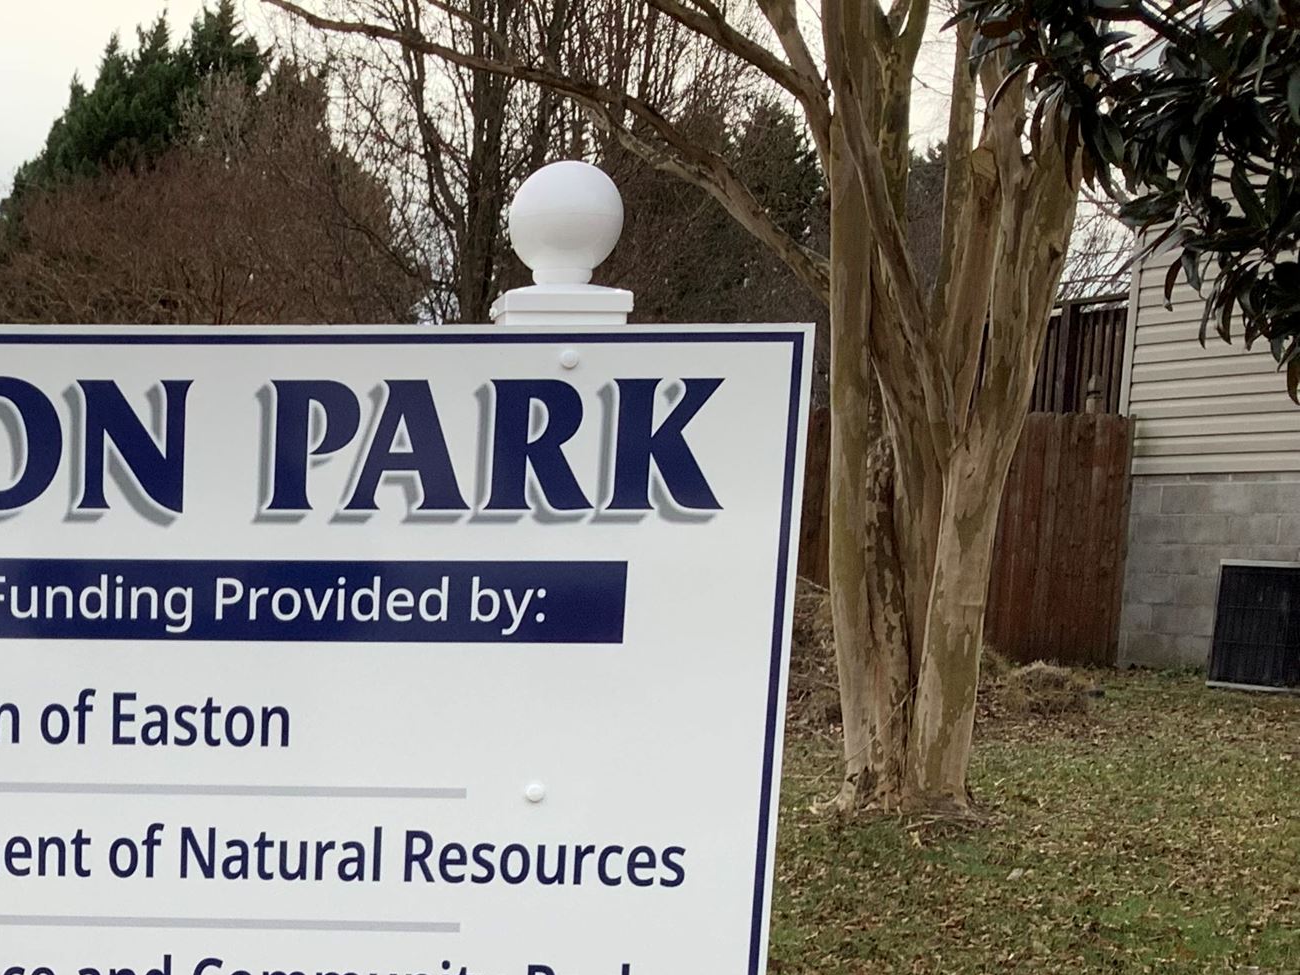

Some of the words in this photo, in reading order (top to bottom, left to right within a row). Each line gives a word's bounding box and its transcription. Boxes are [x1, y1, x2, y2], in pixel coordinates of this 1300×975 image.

[273, 378, 724, 512] PARK
[213, 574, 450, 623] Provided
[469, 577, 547, 635] by:
[40, 689, 97, 745] of
[113, 693, 290, 747] Easton
[108, 823, 165, 879] of
[181, 825, 383, 882] Natural
[404, 831, 686, 887] Resources
